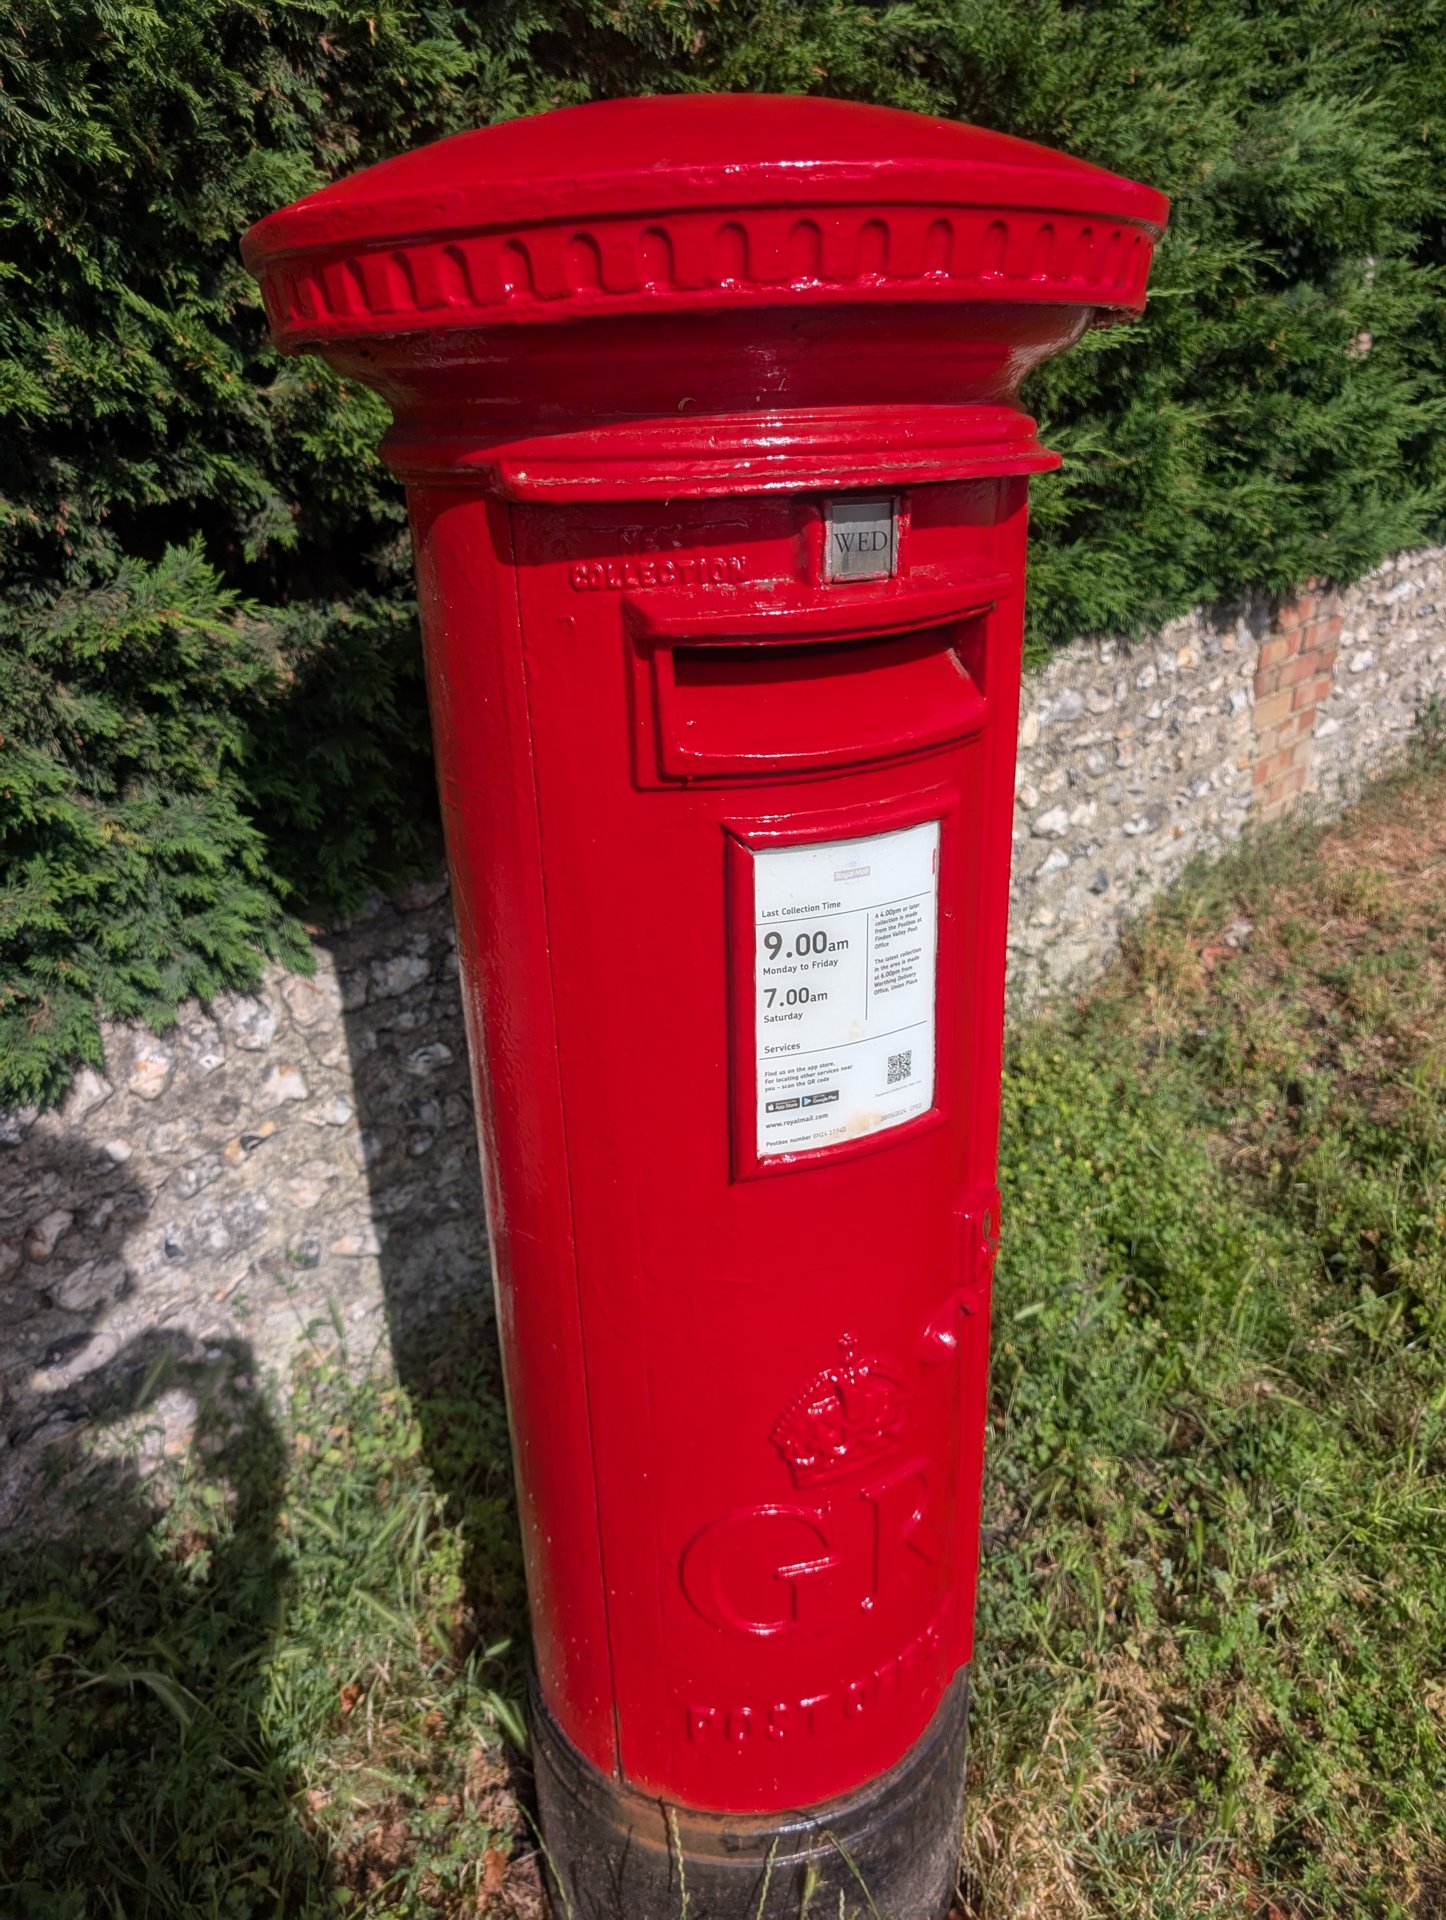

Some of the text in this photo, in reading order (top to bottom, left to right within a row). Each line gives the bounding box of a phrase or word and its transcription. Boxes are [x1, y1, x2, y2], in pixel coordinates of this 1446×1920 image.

[833, 530, 888, 553] WED
[570, 557, 747, 591] COLLECTION
[835, 867, 869, 881] Royal Mail
[762, 901, 841, 918] Last Collection Time
[880, 908, 901, 917] 4.00pm
[875, 916, 898, 927] collection
[898, 920, 916, 928] Postbox
[875, 934, 891, 942] Findon
[764, 931, 849, 961] 9.00am
[900, 947, 921, 957] collection
[763, 963, 797, 976] Monday
[812, 958, 838, 969] Friday
[881, 969, 900, 978] 6.00pm
[874, 972, 916, 987] Worthing Delivery
[764, 987, 828, 1008] 7.00am
[764, 1011, 803, 1023] Saturday
[764, 1042, 801, 1054] Services
[819, 1061, 835, 1069] store.
[776, 1074, 799, 1083] locating
[817, 1068, 839, 1076] services
[841, 1064, 853, 1073] near
[765, 1085, 776, 1093] you
[766, 1112, 829, 1129] www.royalmail.com
[766, 1139, 788, 1147] Postbox
[790, 1135, 811, 1143] number
[684, 1694, 830, 1742] POST
